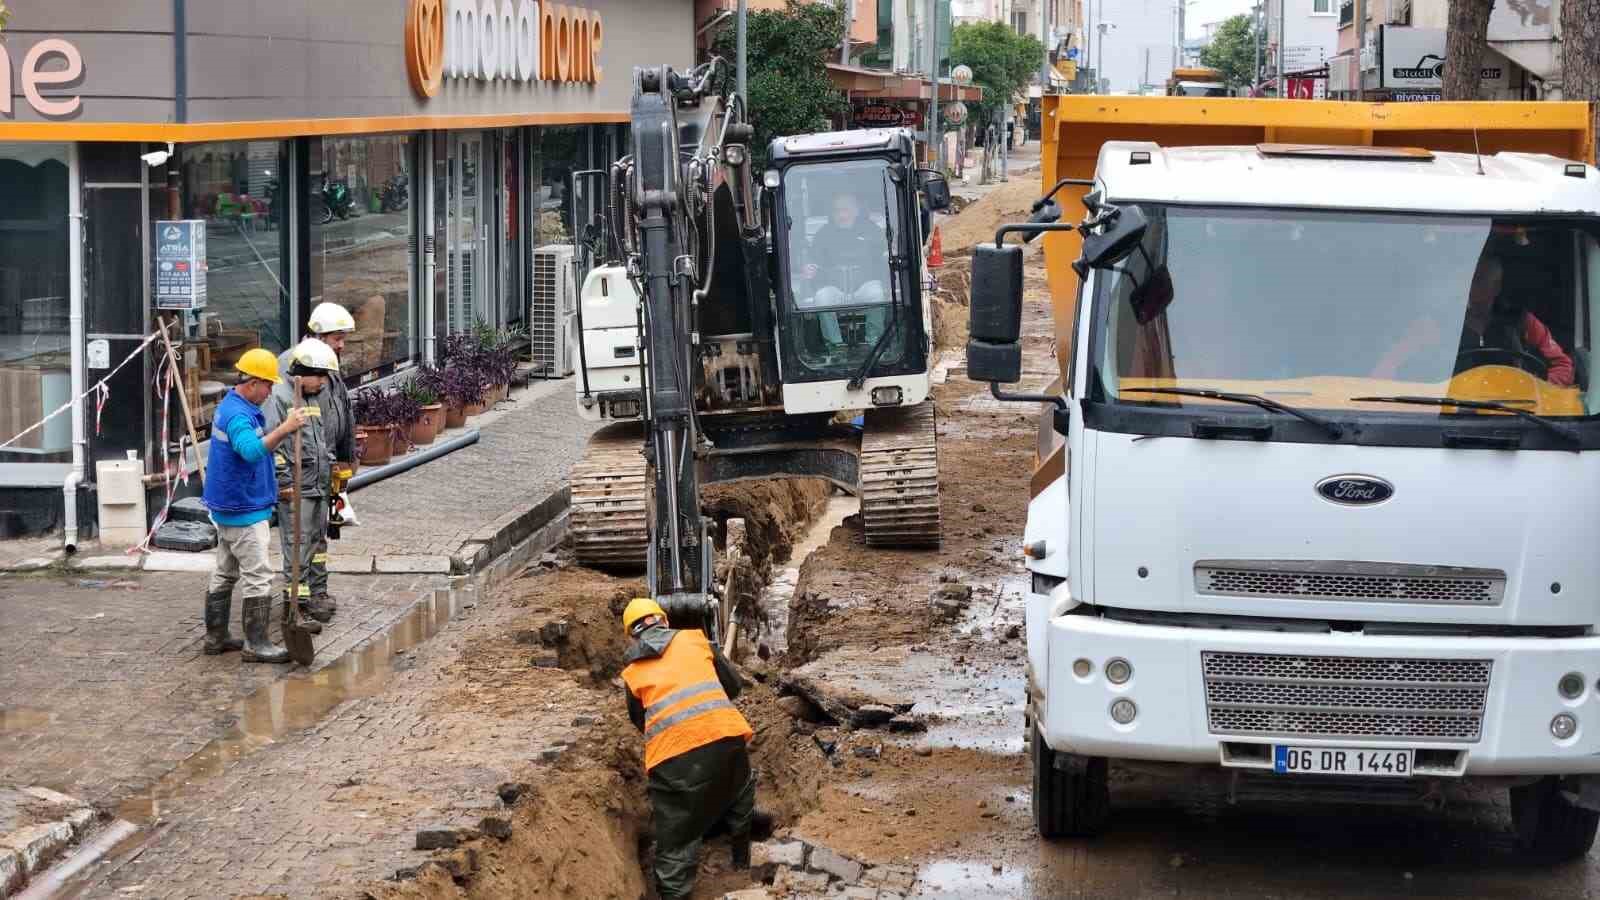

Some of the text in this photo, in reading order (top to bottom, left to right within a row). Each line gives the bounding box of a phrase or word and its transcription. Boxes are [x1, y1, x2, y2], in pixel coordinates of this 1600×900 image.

[1334, 480, 1377, 498] Ford
[1287, 750, 1312, 770] 06
[1321, 751, 1346, 771] DR
[1357, 752, 1407, 773] 1448
